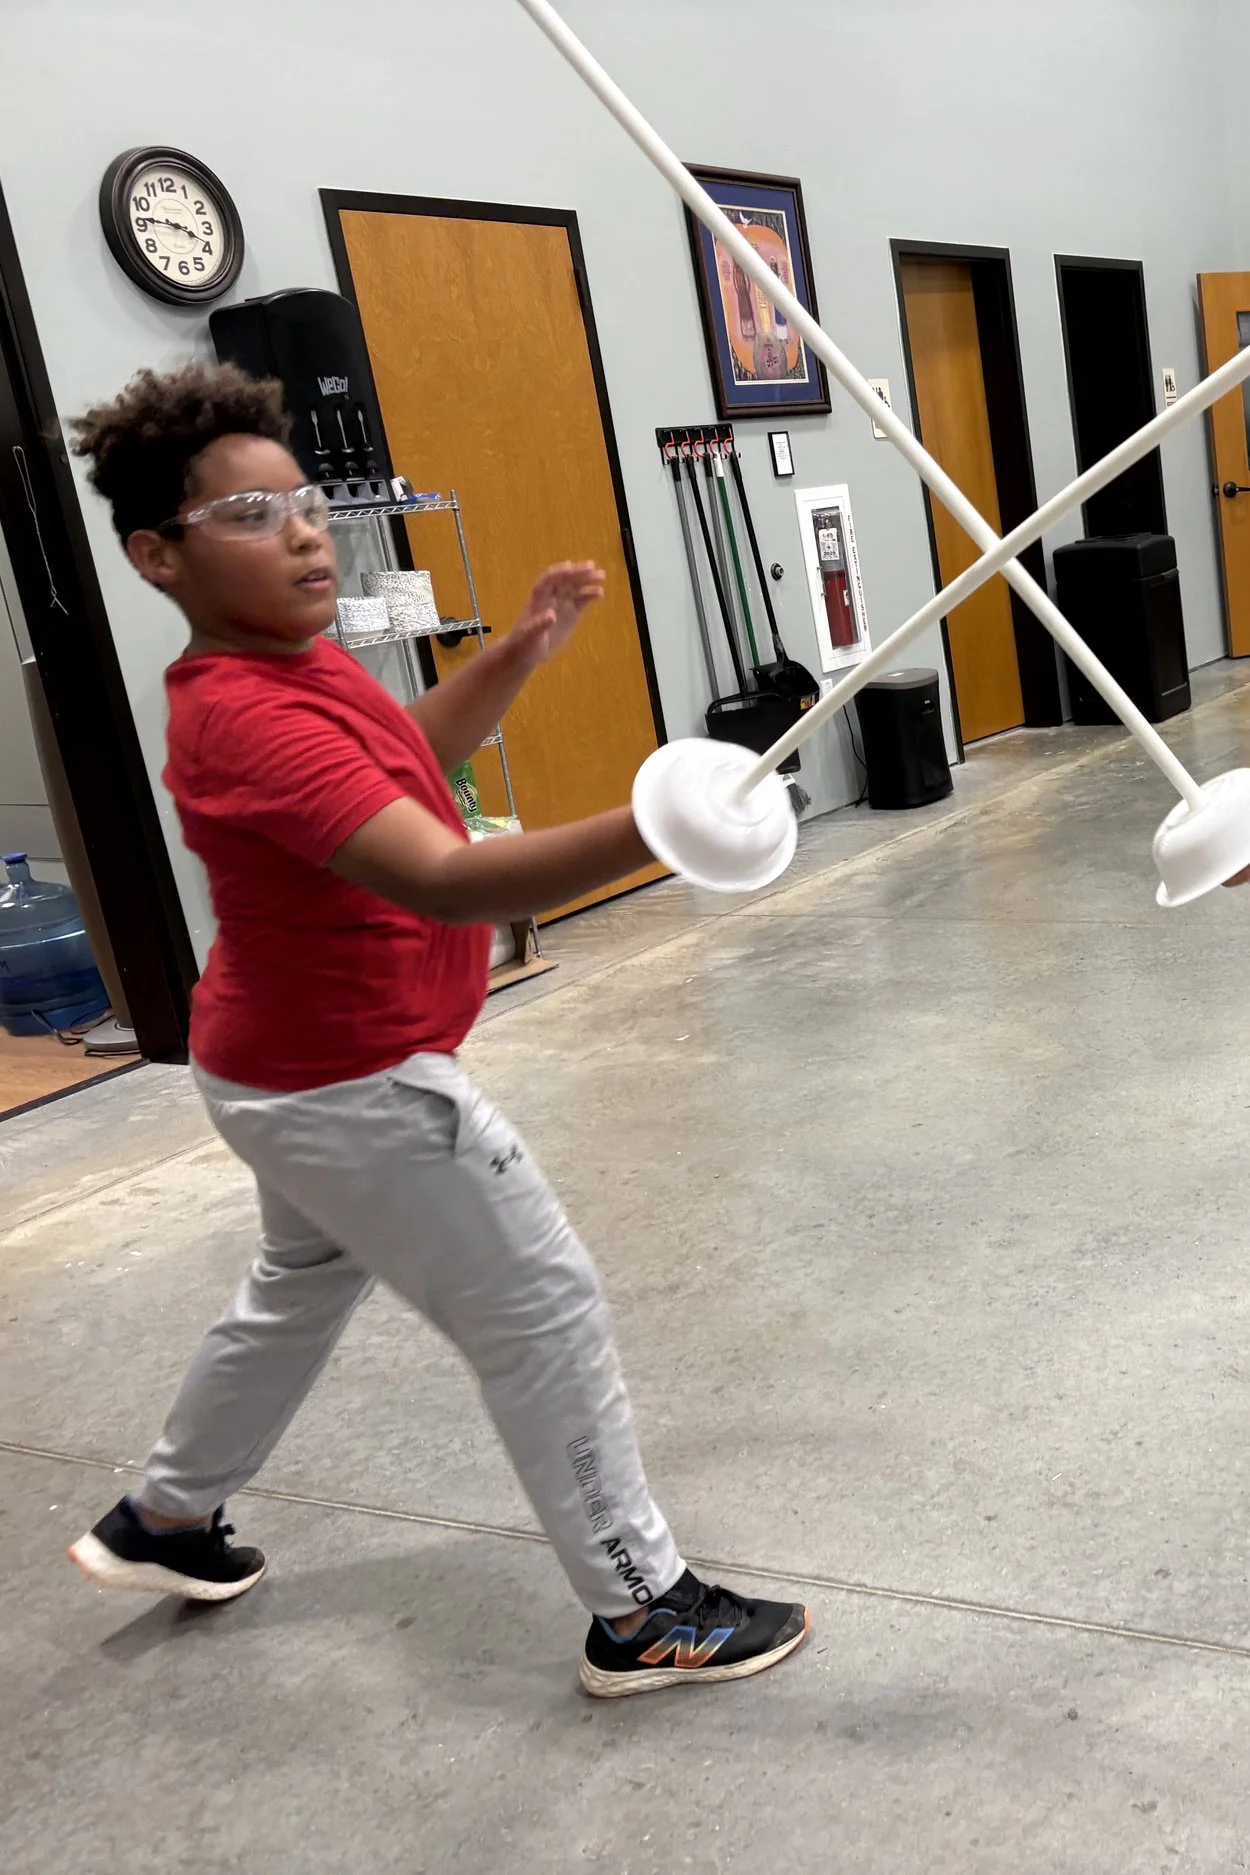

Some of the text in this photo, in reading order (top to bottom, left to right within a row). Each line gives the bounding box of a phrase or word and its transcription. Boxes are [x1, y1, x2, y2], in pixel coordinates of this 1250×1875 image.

[144, 182, 158, 198] 11
[158, 177, 177, 193] 12
[181, 184, 188, 200] 1
[132, 196, 150, 212] 10
[193, 200, 207, 216] 2
[135, 217, 148, 233] 9
[201, 221, 214, 236] 3
[145, 238, 158, 254] 8
[201, 241, 213, 256] 4
[158, 256, 171, 271] 7
[178, 260, 190, 276] 6
[193, 256, 206, 272] 5
[456, 778, 477, 812] Bounty
